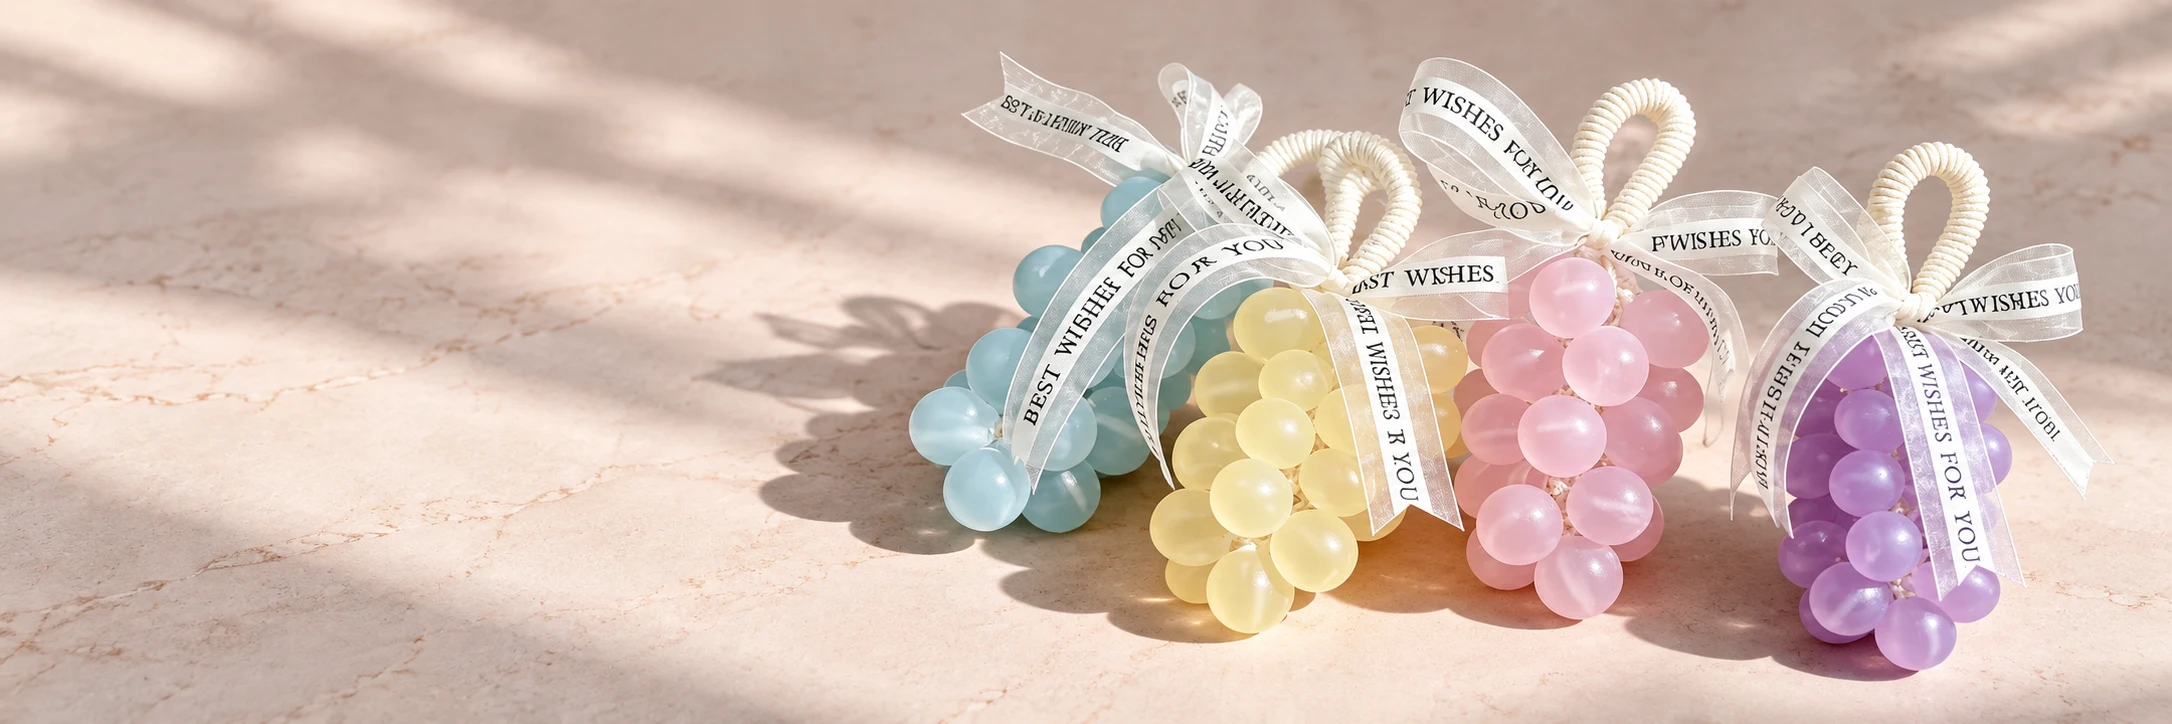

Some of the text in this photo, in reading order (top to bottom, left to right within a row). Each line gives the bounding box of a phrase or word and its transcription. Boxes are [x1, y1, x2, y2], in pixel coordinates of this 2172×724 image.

[1423, 87, 1504, 141] WISHES
[1023, 363, 1061, 426] BEST
[1117, 246, 1154, 278] FOR
[1918, 363, 1981, 563] WISHES FOR YOU
